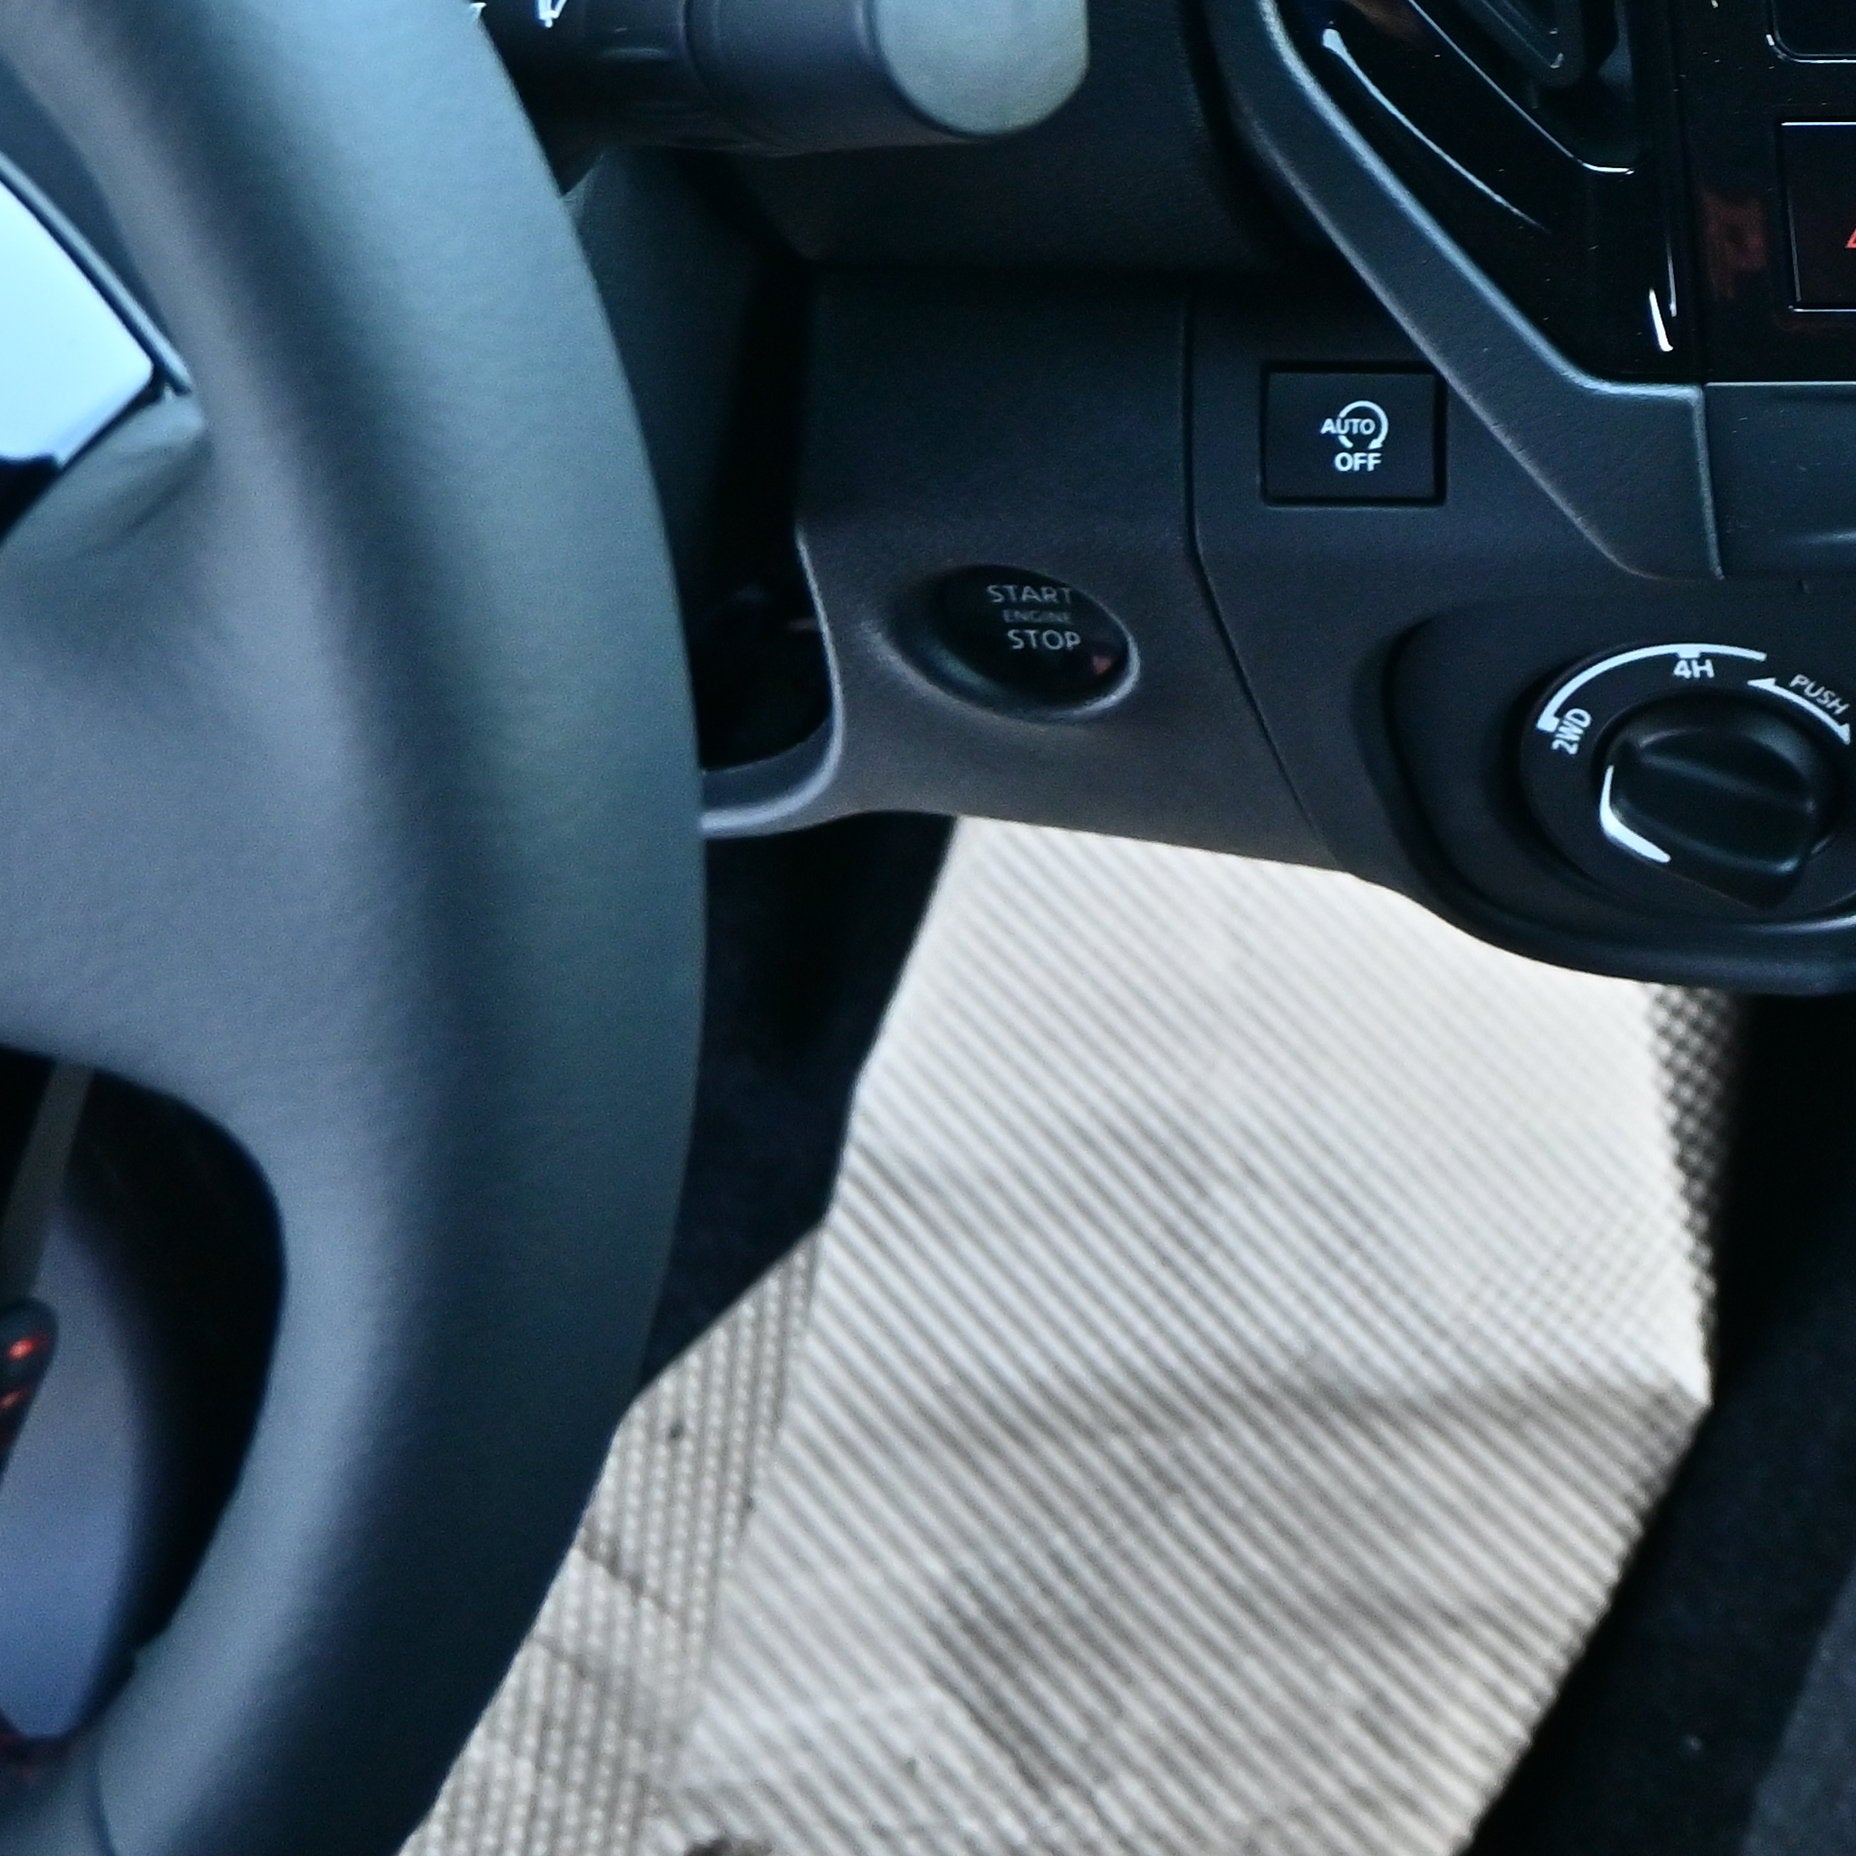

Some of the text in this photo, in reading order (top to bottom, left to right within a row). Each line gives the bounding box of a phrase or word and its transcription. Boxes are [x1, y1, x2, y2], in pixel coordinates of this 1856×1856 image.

[1320, 418, 1376, 435] AUTO
[1334, 452, 1382, 472] OFF
[986, 584, 1073, 605] START
[1007, 629, 1081, 651] STOP
[1673, 658, 1715, 680] 4H
[1788, 673, 1850, 716] PUSH
[1551, 707, 1594, 756] 2WD
